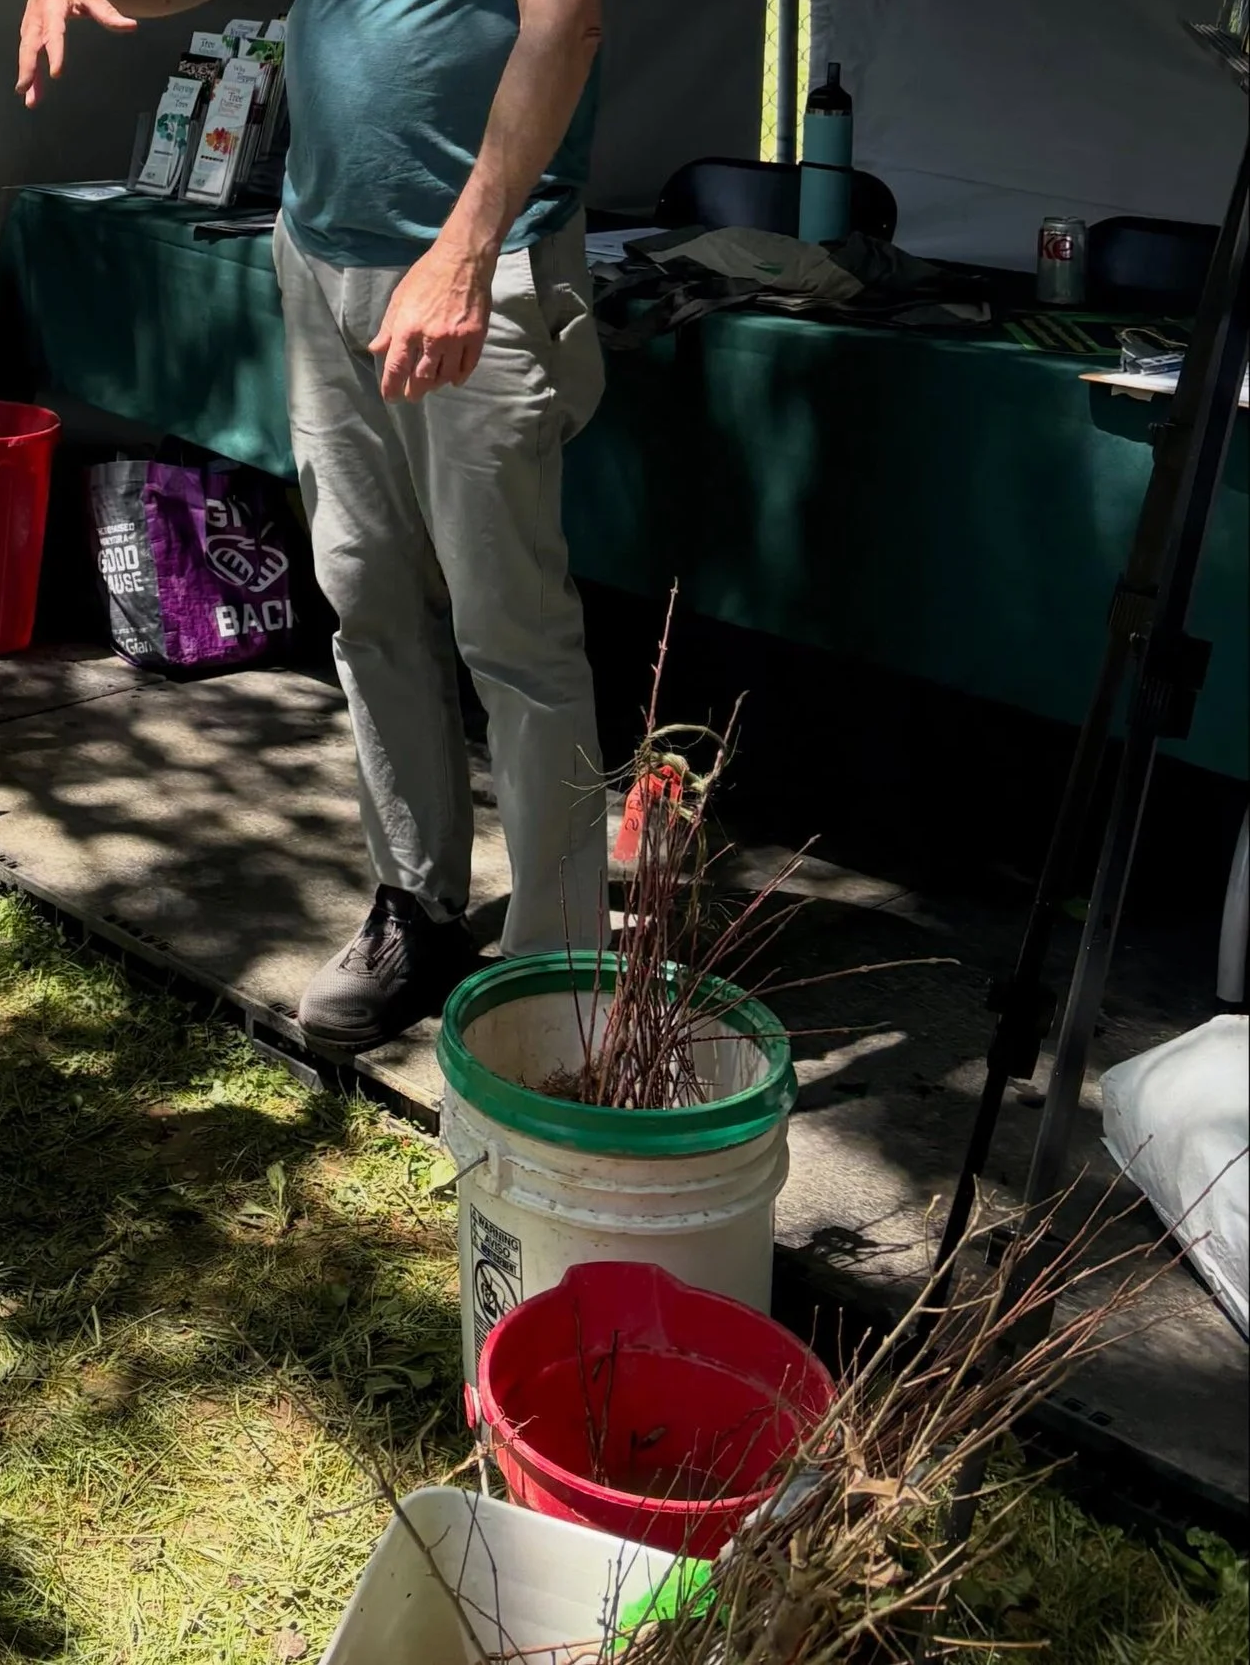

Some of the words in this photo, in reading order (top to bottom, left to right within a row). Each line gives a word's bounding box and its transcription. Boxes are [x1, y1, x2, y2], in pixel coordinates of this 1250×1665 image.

[105, 571, 145, 595] AUSE
[478, 1215, 519, 1252] WARNING
[484, 1233, 511, 1260] AVISO
